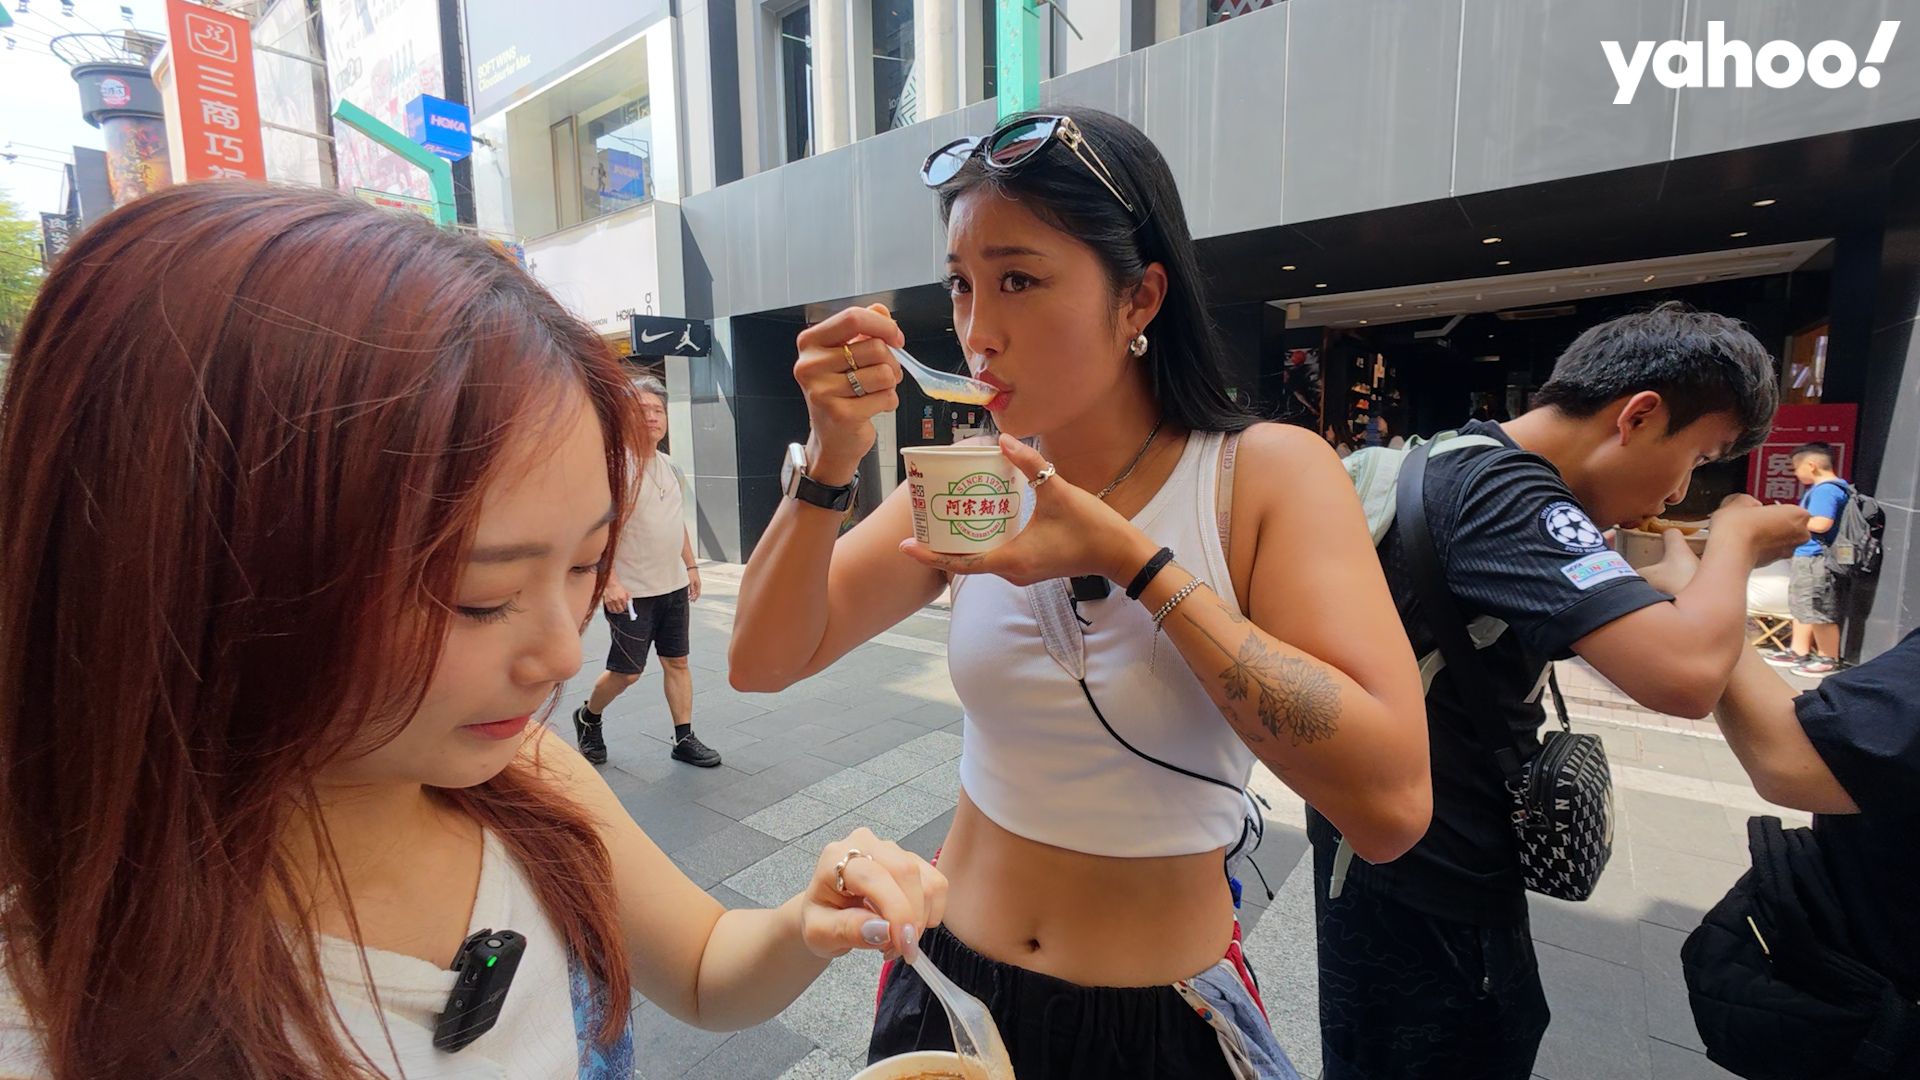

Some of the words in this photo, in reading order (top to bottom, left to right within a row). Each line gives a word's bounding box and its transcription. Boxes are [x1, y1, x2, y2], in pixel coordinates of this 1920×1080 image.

[430, 113, 467, 134] HOKA
[957, 475, 984, 494] SINCE
[985, 475, 1002, 492] 1975
[1765, 477, 1805, 499] 商
[946, 498, 1011, 517] 阿宗麵線
